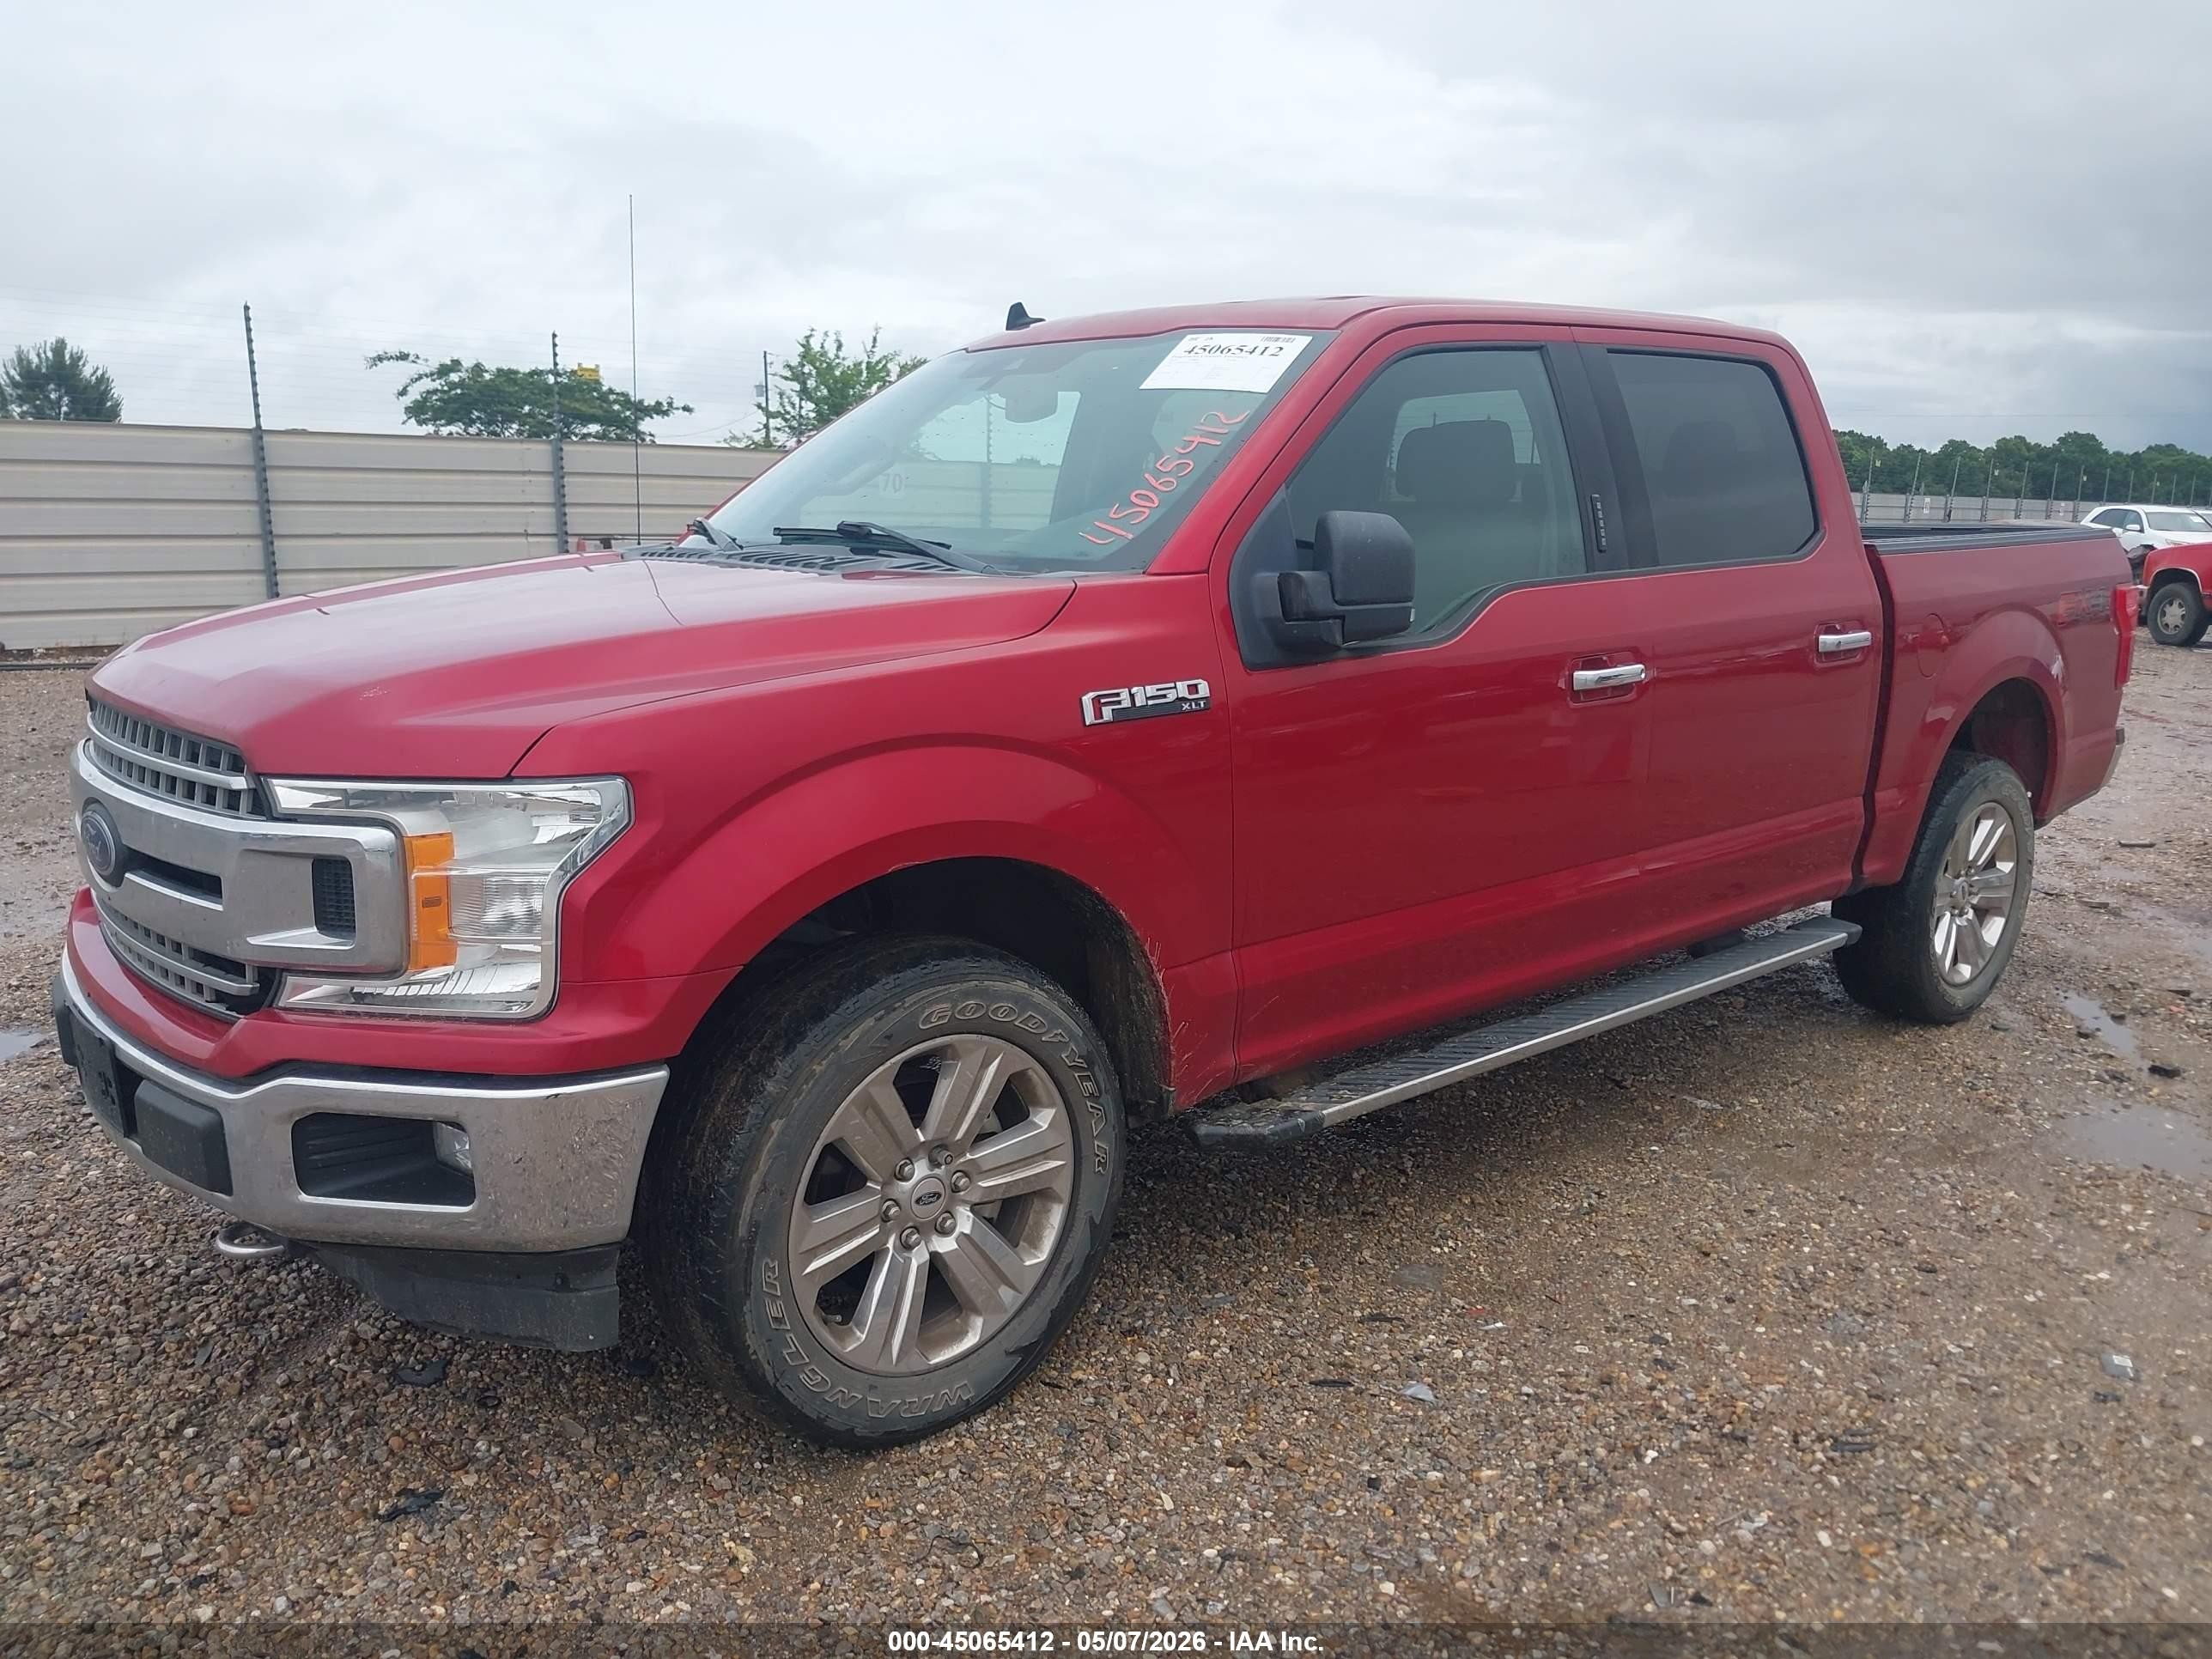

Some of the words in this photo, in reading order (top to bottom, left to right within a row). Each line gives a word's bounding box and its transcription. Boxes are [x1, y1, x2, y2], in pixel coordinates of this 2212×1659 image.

[1184, 344, 1284, 357] 45065412
[1079, 410, 1250, 544] 45065412
[1181, 700, 1206, 711] XLT
[919, 1001, 1110, 1175] GOODYEAR
[762, 1258, 975, 1419] WRANGLER
